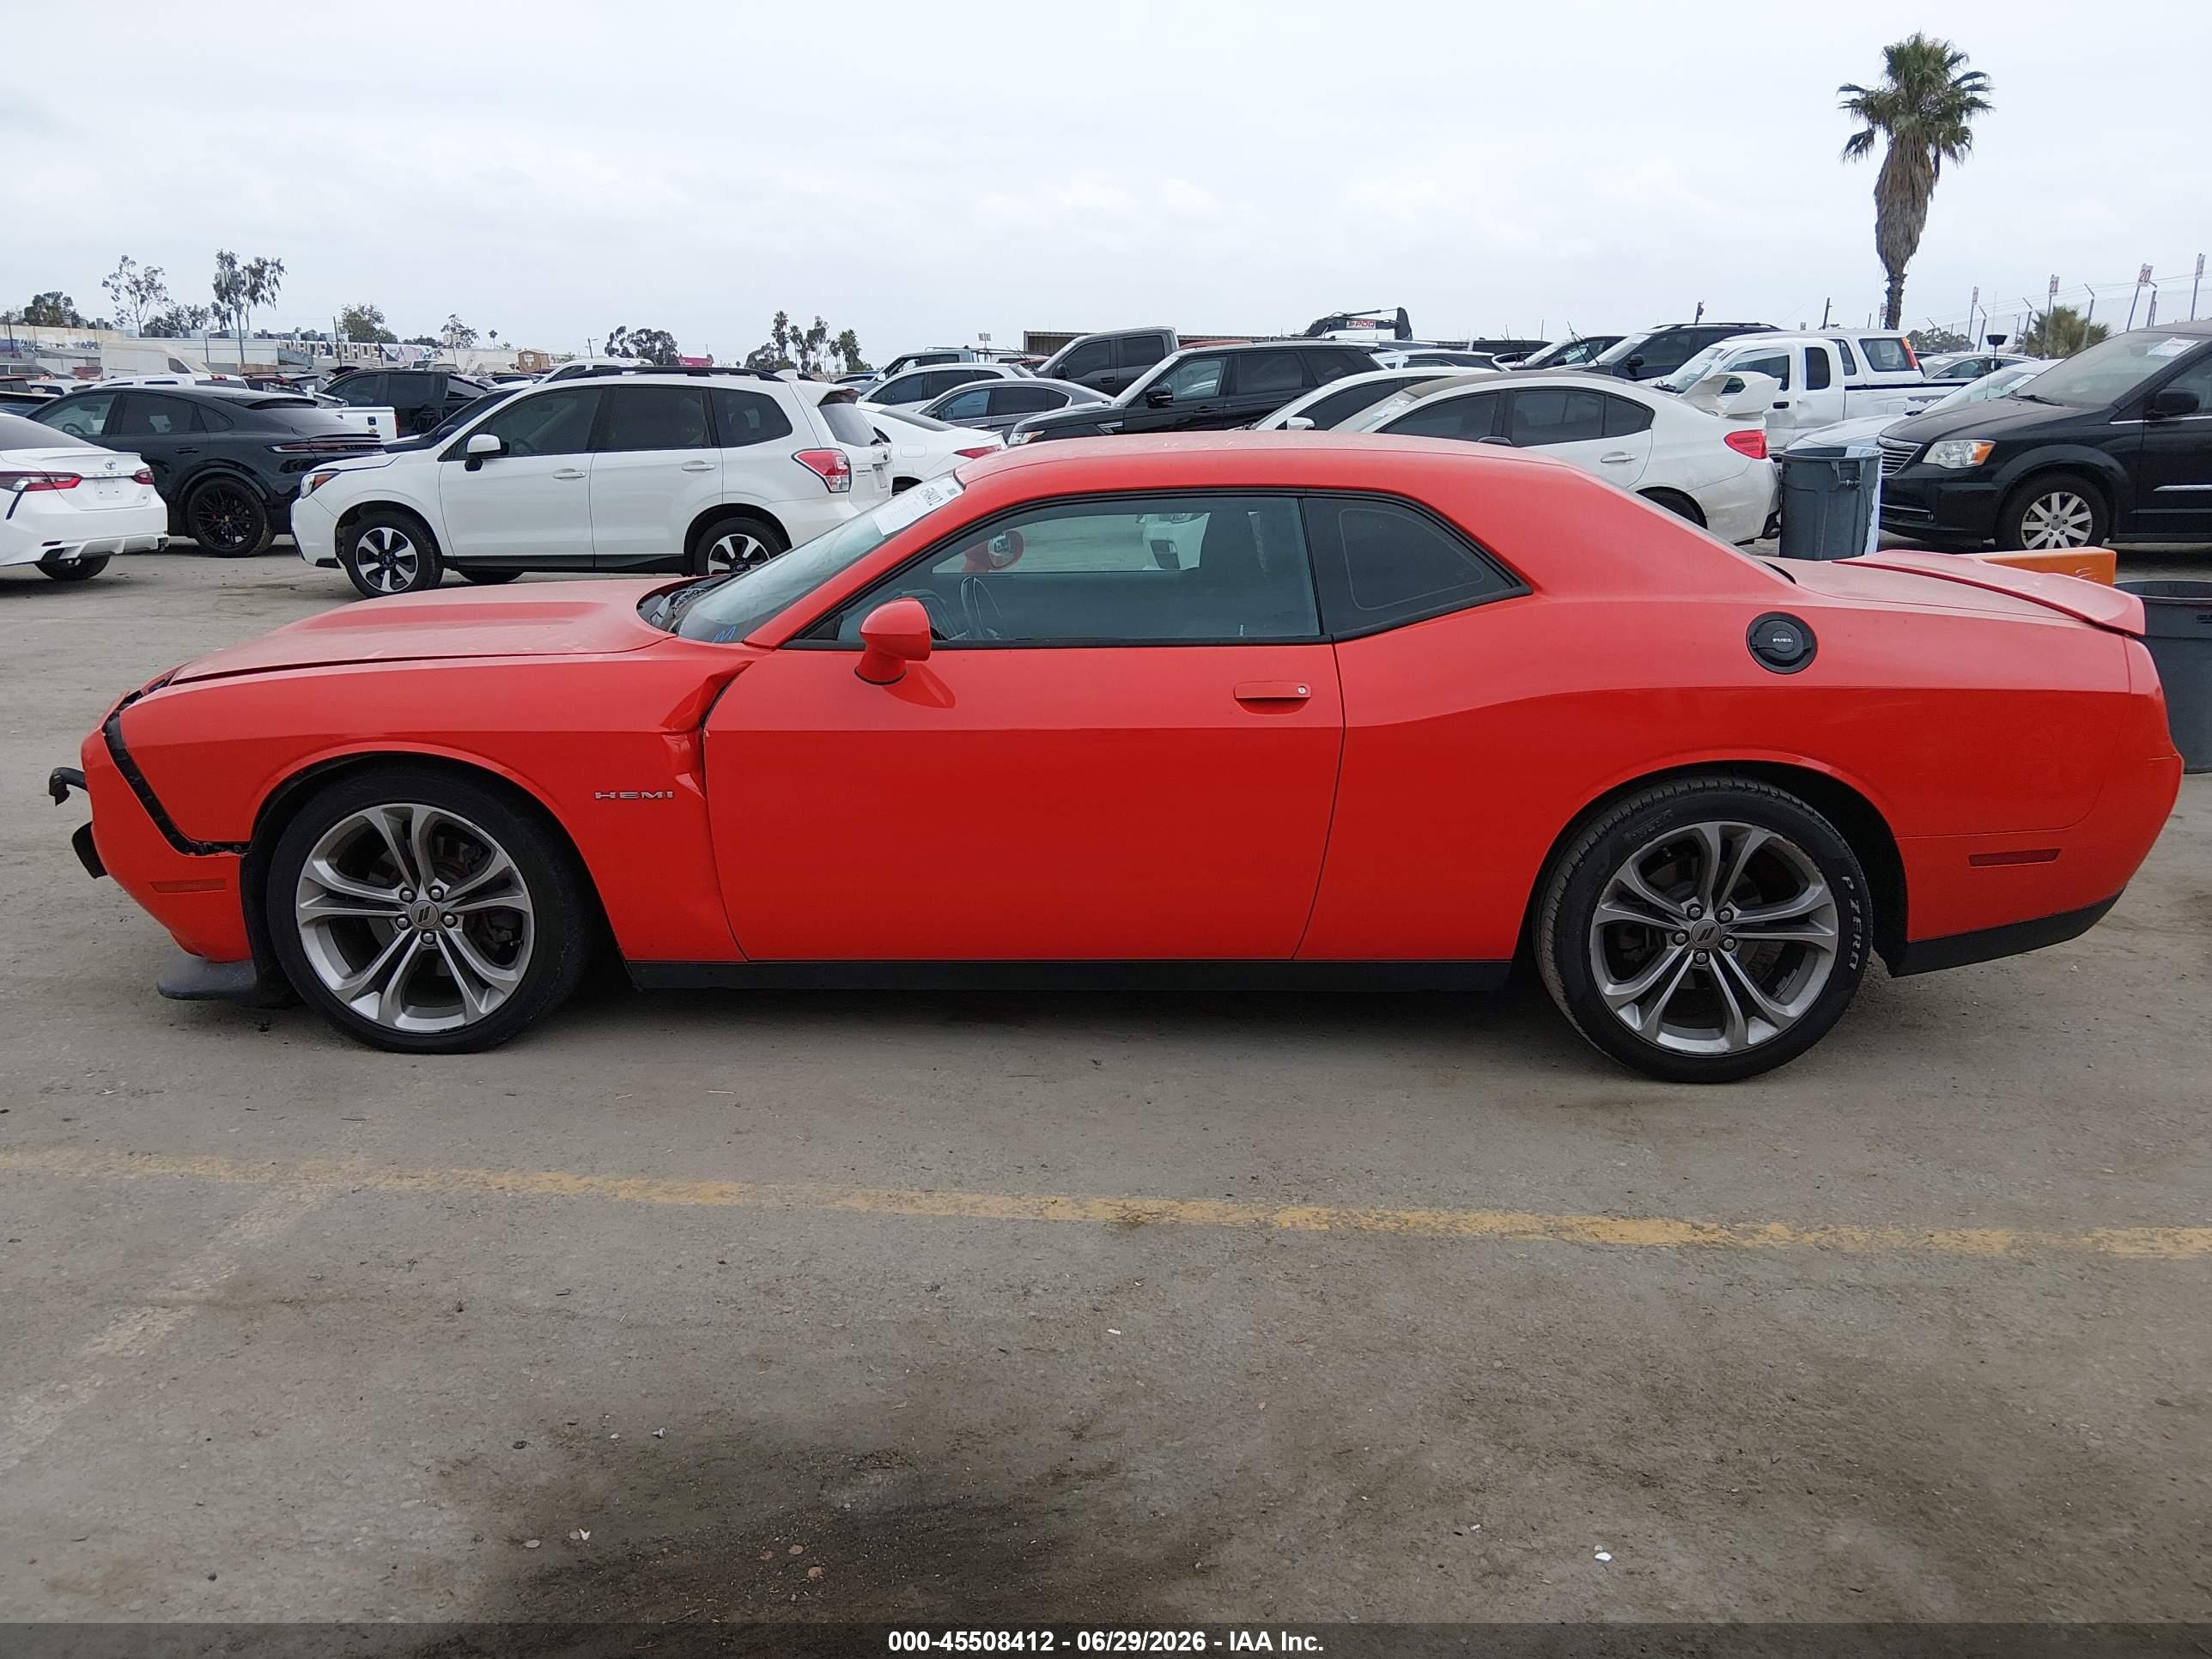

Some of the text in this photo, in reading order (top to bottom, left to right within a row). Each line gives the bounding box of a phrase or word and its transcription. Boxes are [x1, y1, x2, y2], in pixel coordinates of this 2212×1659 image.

[2138, 268, 2151, 283] 20
[2049, 280, 2058, 293] 21
[594, 791, 674, 799] HEMI
[1841, 876, 1863, 970] P ZERO
